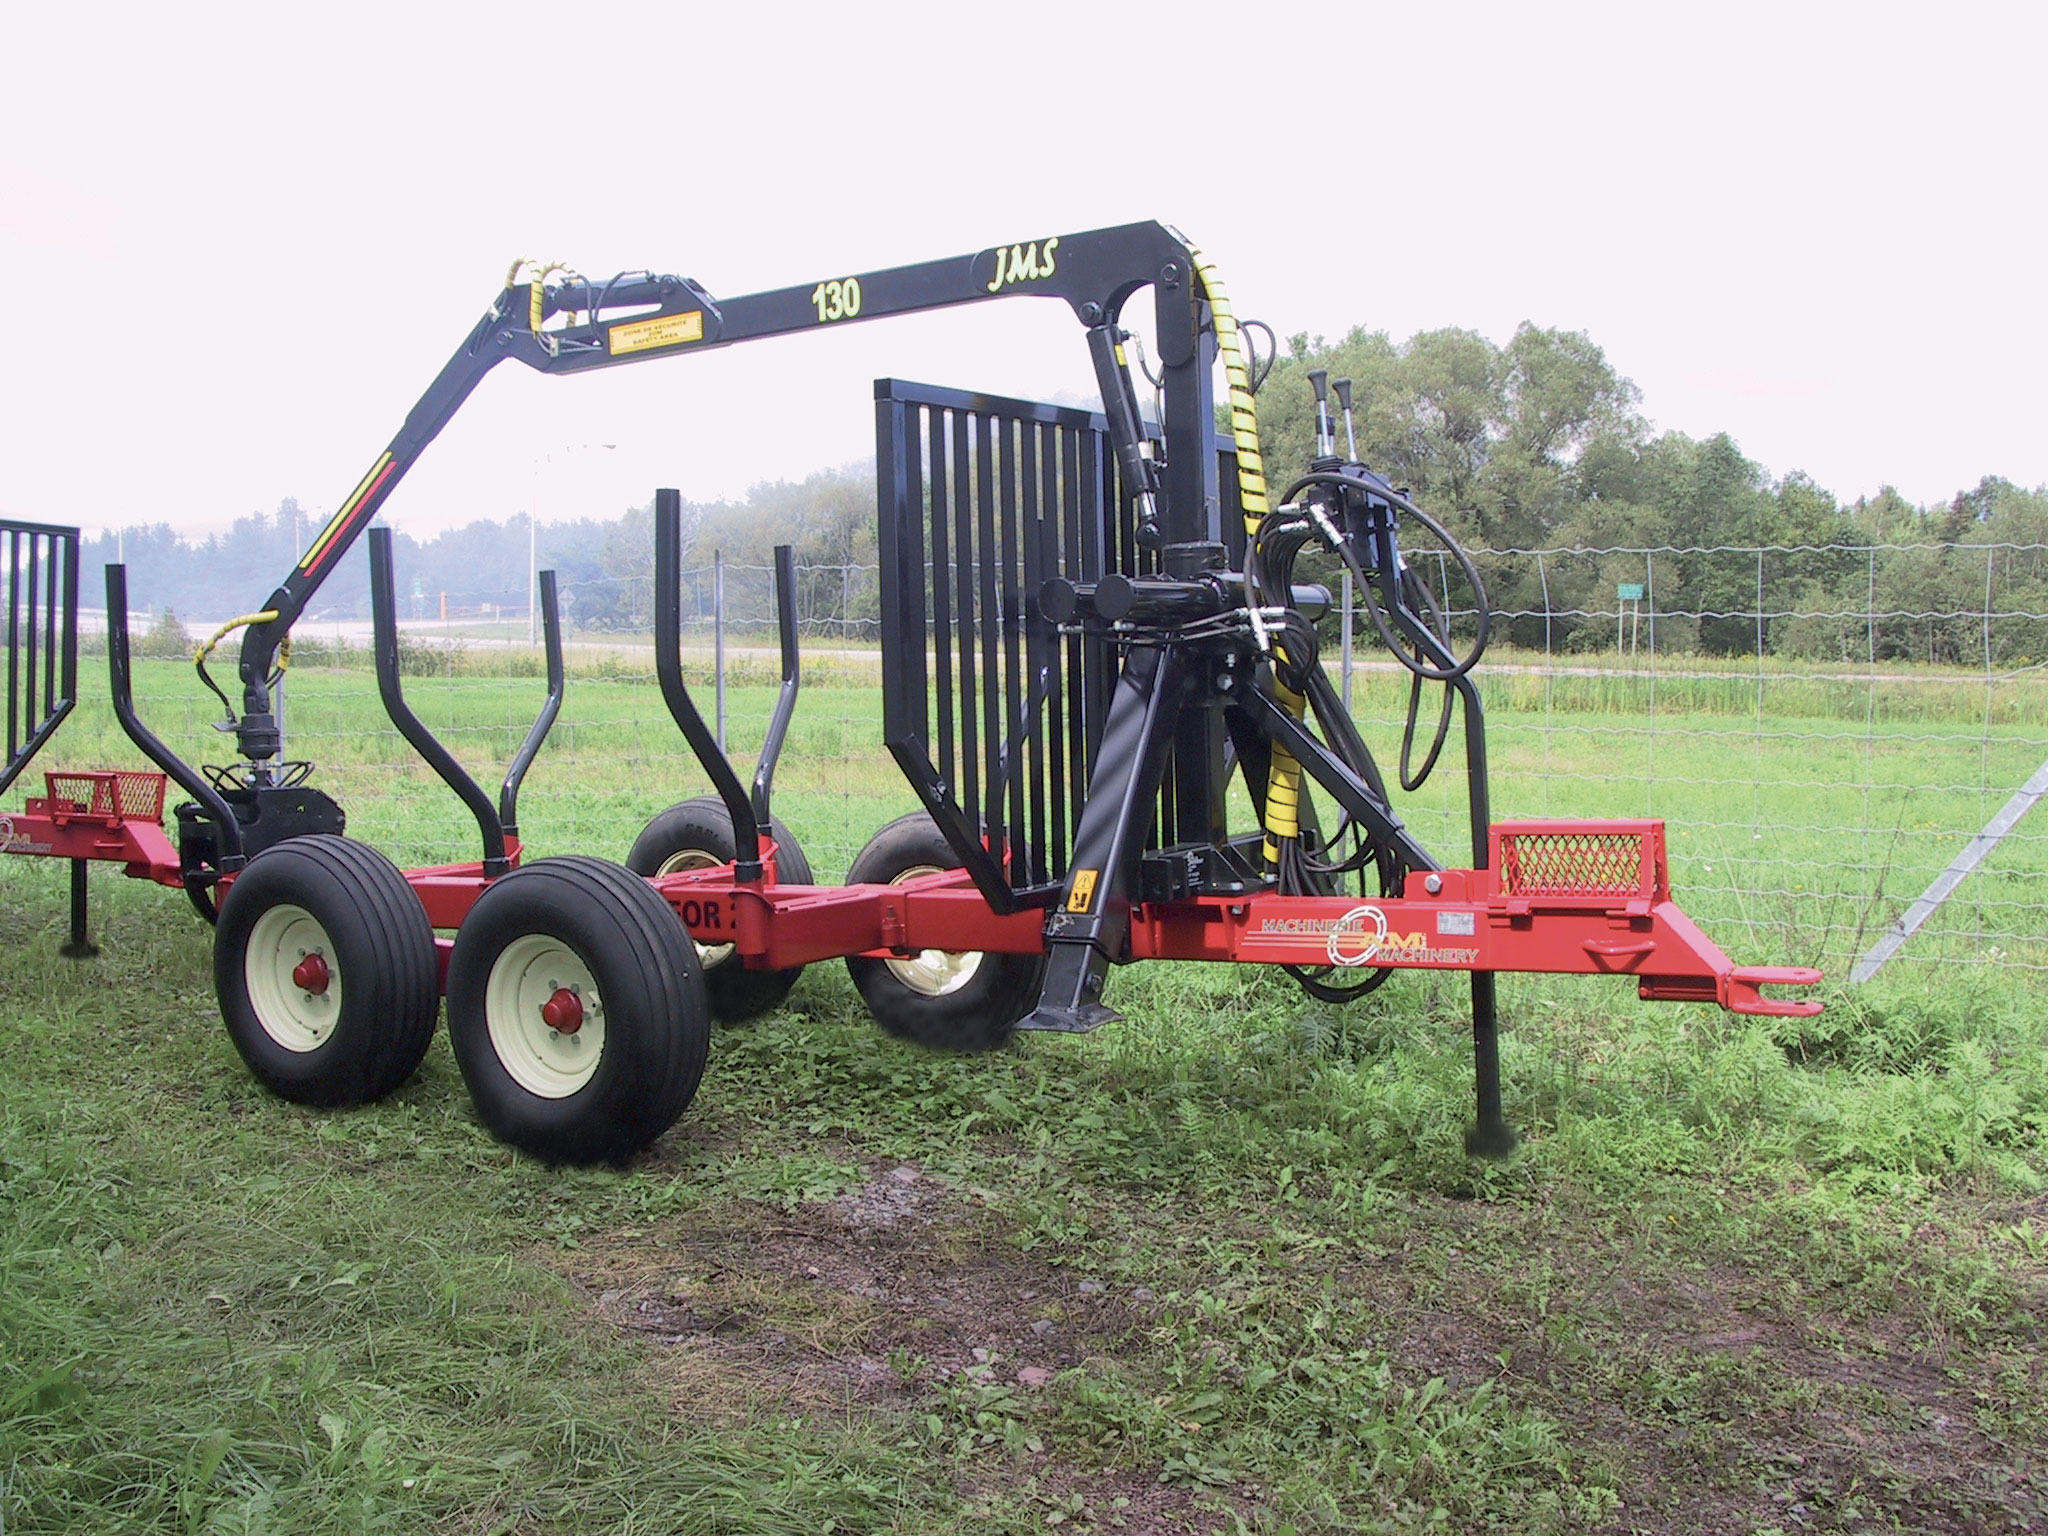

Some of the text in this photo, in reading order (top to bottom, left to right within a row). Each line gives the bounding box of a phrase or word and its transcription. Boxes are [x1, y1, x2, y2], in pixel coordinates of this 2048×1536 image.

[987, 237, 1058, 292] JMS
[812, 276, 861, 322] 130
[633, 332, 678, 345] SAFETY AREA
[667, 900, 721, 929] OR
[1262, 919, 1365, 933] MACHINERIE
[1376, 948, 1479, 963] MACHINERY
